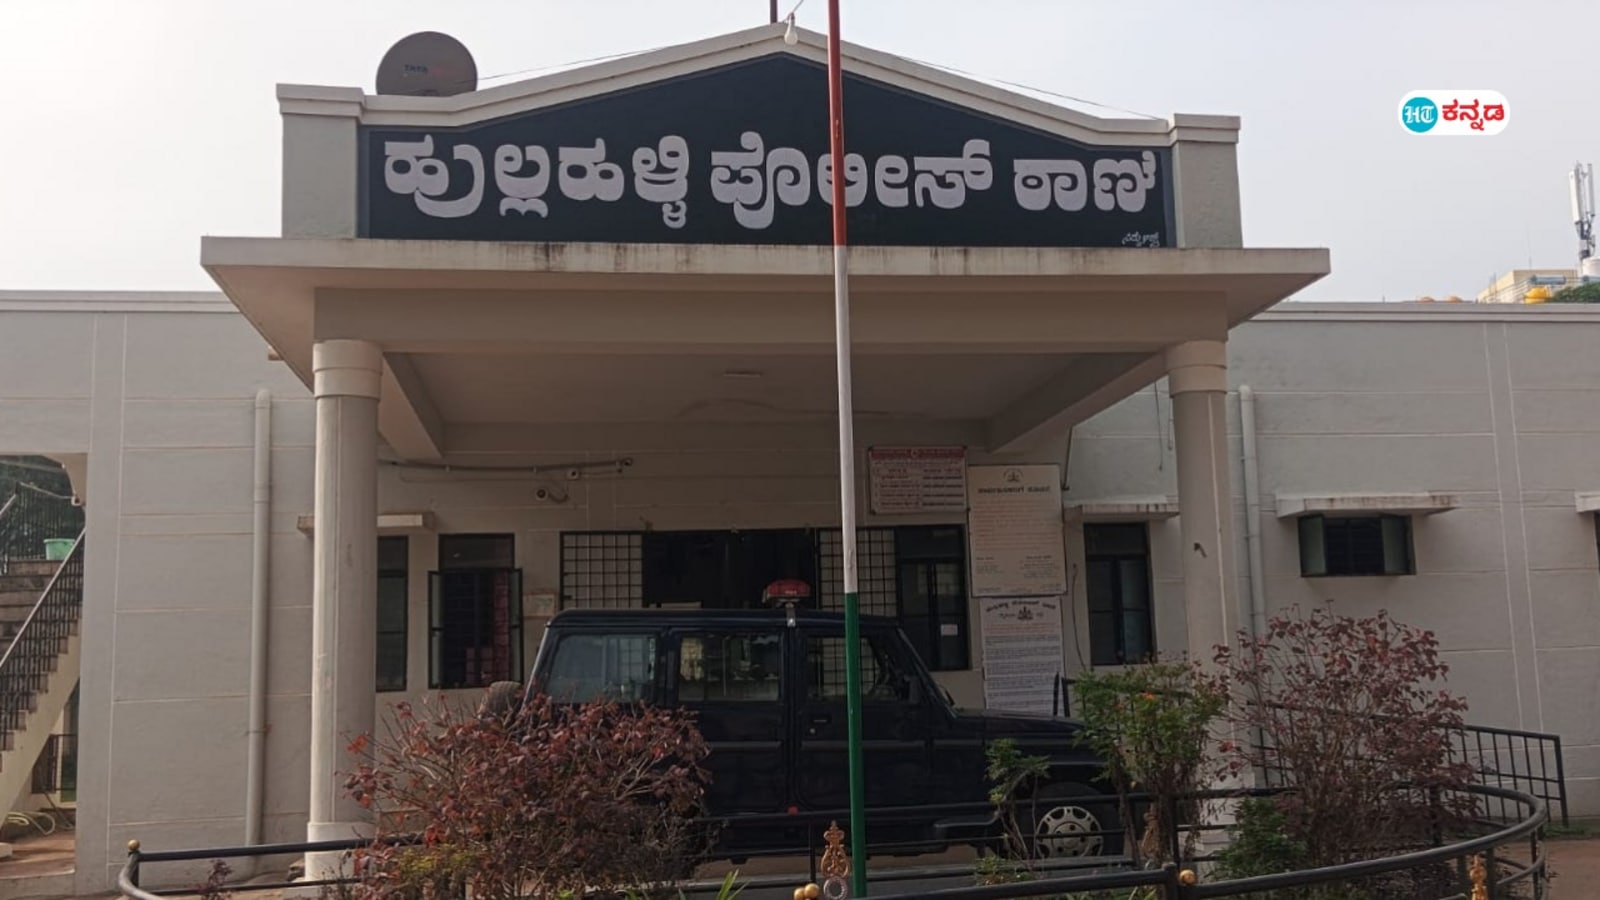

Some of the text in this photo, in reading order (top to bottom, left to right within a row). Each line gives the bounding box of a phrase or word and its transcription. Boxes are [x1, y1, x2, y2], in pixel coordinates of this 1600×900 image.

[384, 130, 1156, 230] ಹುಲ್ಲಹಳ್ಳಿ ಪೊಲೀಸ್ ಠಾಣೆ
